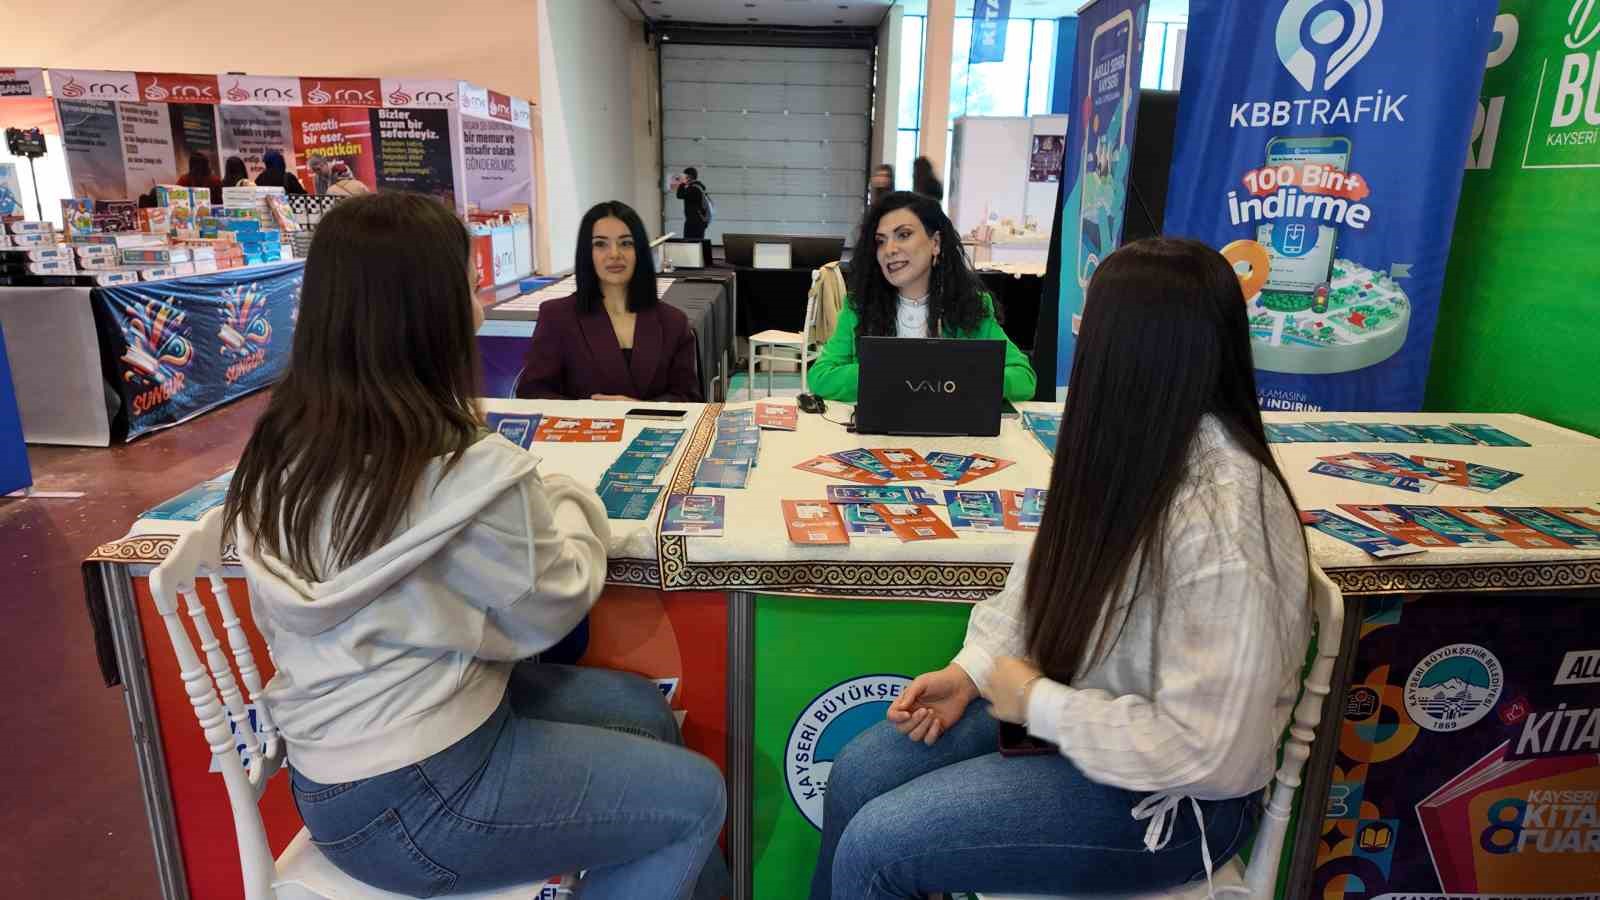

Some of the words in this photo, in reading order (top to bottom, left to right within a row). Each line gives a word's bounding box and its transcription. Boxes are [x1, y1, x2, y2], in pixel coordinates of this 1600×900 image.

[378, 109, 410, 119] Bizler
[1229, 89, 1408, 128] KBBTRAFİK
[379, 120, 406, 128] uzun
[407, 119, 423, 128] bir
[303, 133, 318, 144] bir
[380, 129, 440, 141] seferdeyiz.
[464, 131, 475, 143] bir
[476, 134, 504, 143] memur
[505, 134, 515, 144] ve
[464, 144, 491, 155] misafir
[492, 145, 515, 156] olarak
[1243, 165, 1294, 193] 100
[1302, 163, 1360, 192] Bin+
[1227, 189, 1371, 229] İndirme
[905, 379, 956, 394] VAIO
[795, 722, 818, 801] KAYSERİ
